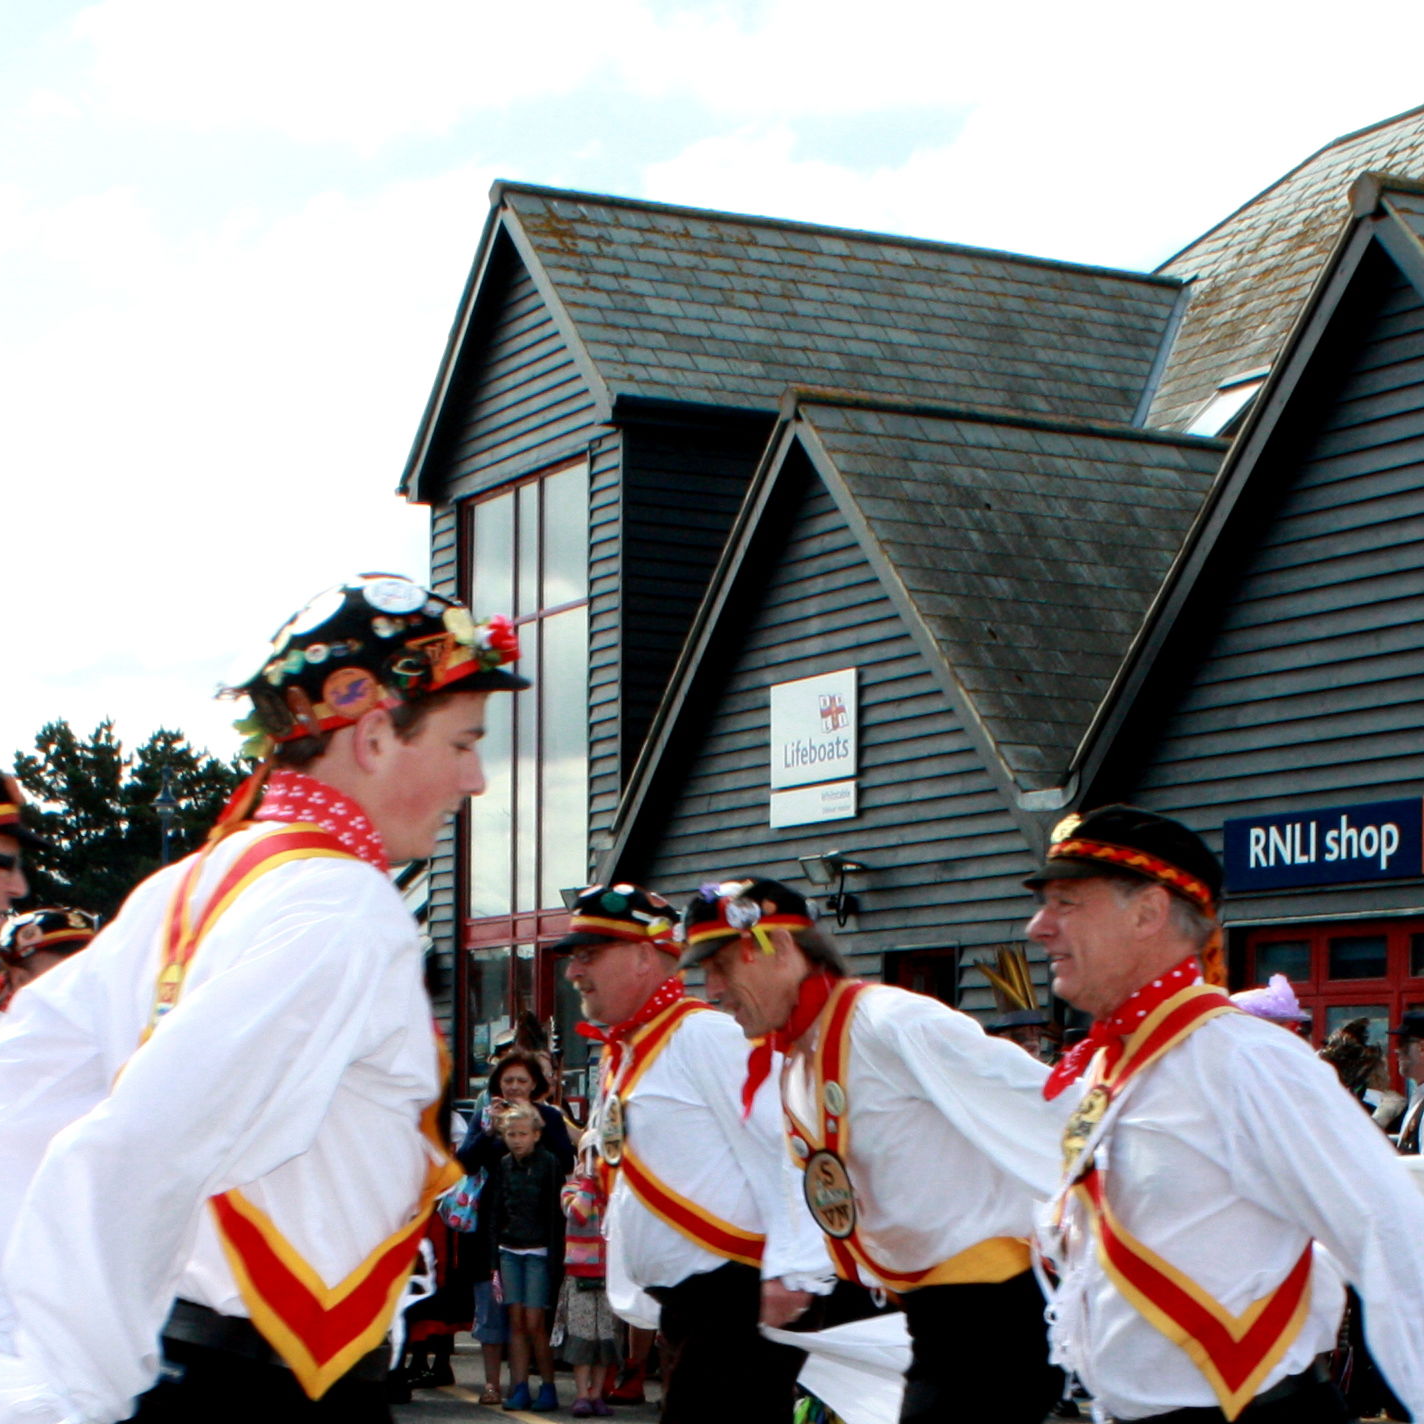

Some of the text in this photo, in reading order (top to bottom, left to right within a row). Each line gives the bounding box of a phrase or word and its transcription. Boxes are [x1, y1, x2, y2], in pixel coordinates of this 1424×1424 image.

[784, 737, 849, 769] Lifeboats
[1249, 821, 1317, 869] RNLI
[1324, 814, 1400, 871] shop
